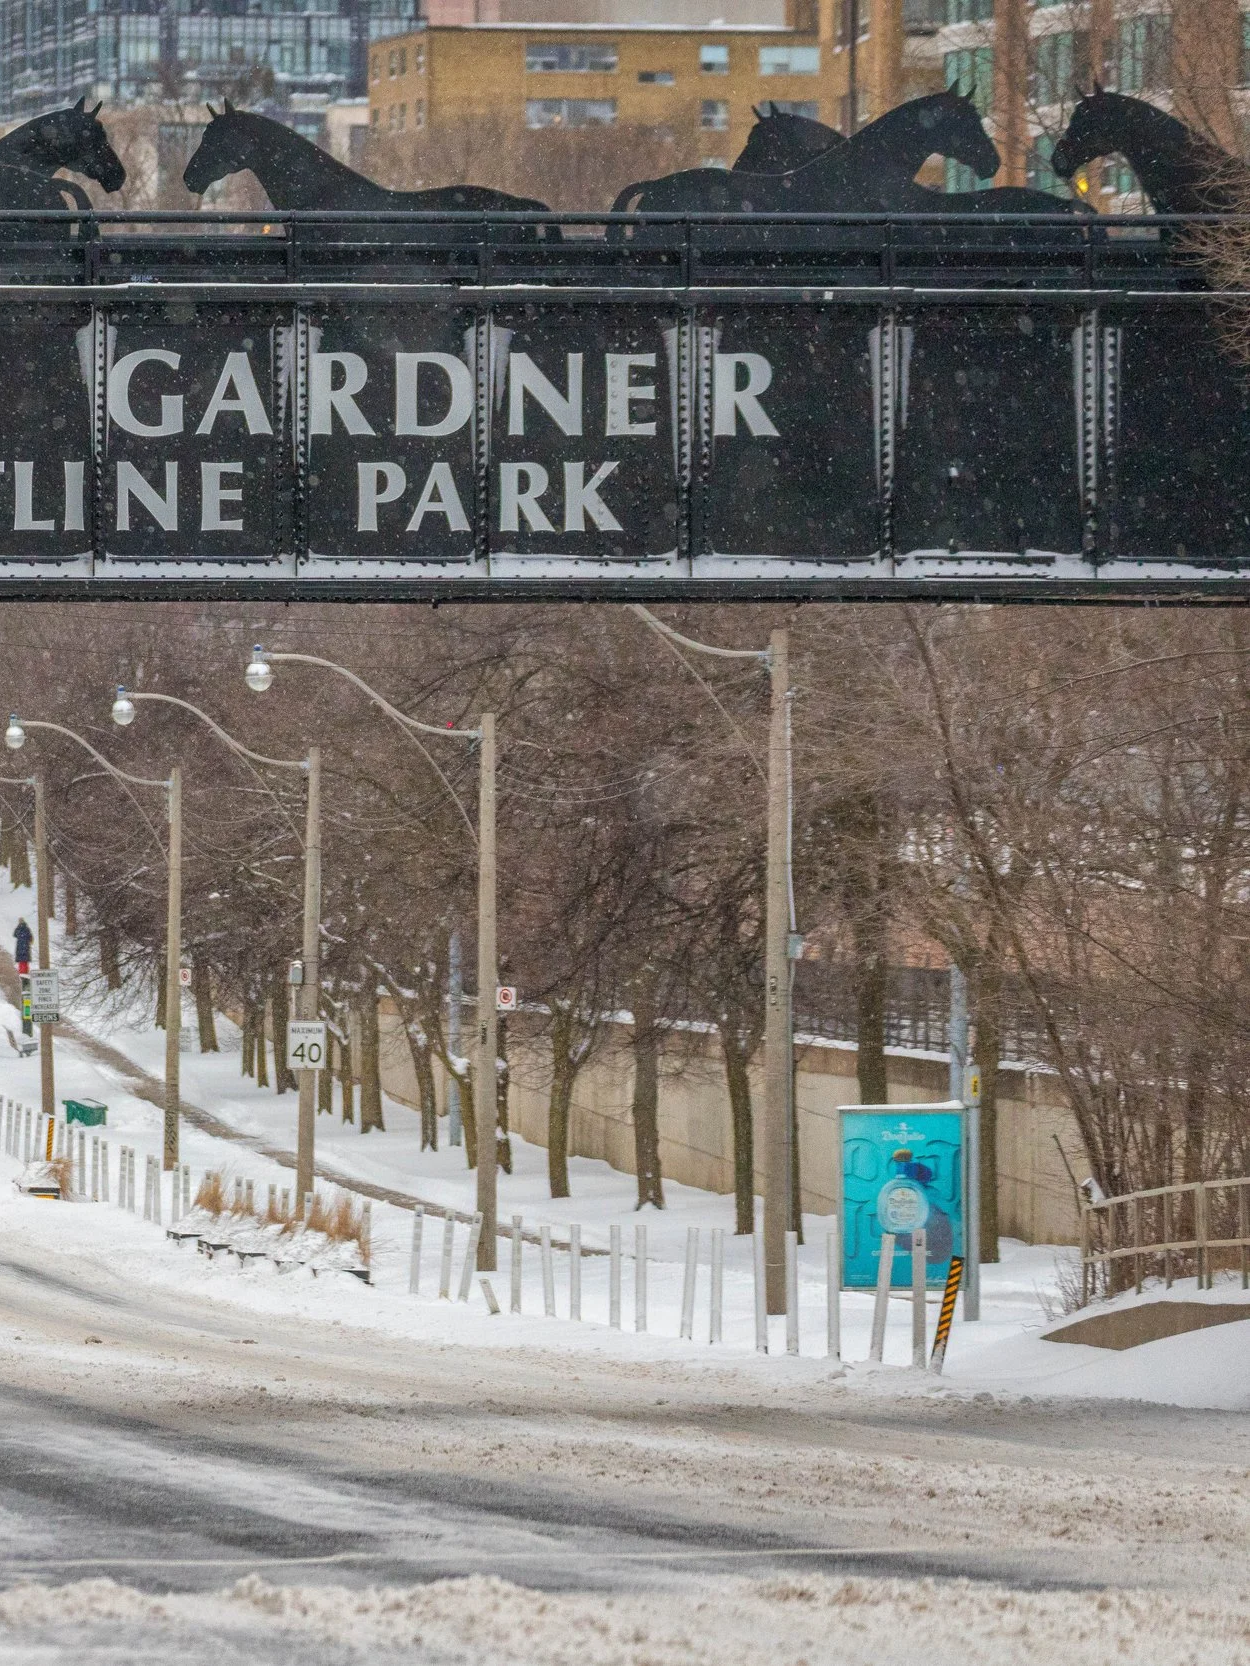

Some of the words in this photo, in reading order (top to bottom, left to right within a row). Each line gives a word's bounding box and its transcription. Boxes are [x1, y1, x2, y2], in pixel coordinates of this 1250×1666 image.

[107, 347, 781, 437] GARDNER
[356, 460, 624, 533] PARK
[33, 1013, 58, 1021] BEGINS
[291, 1042, 322, 1063] 40
